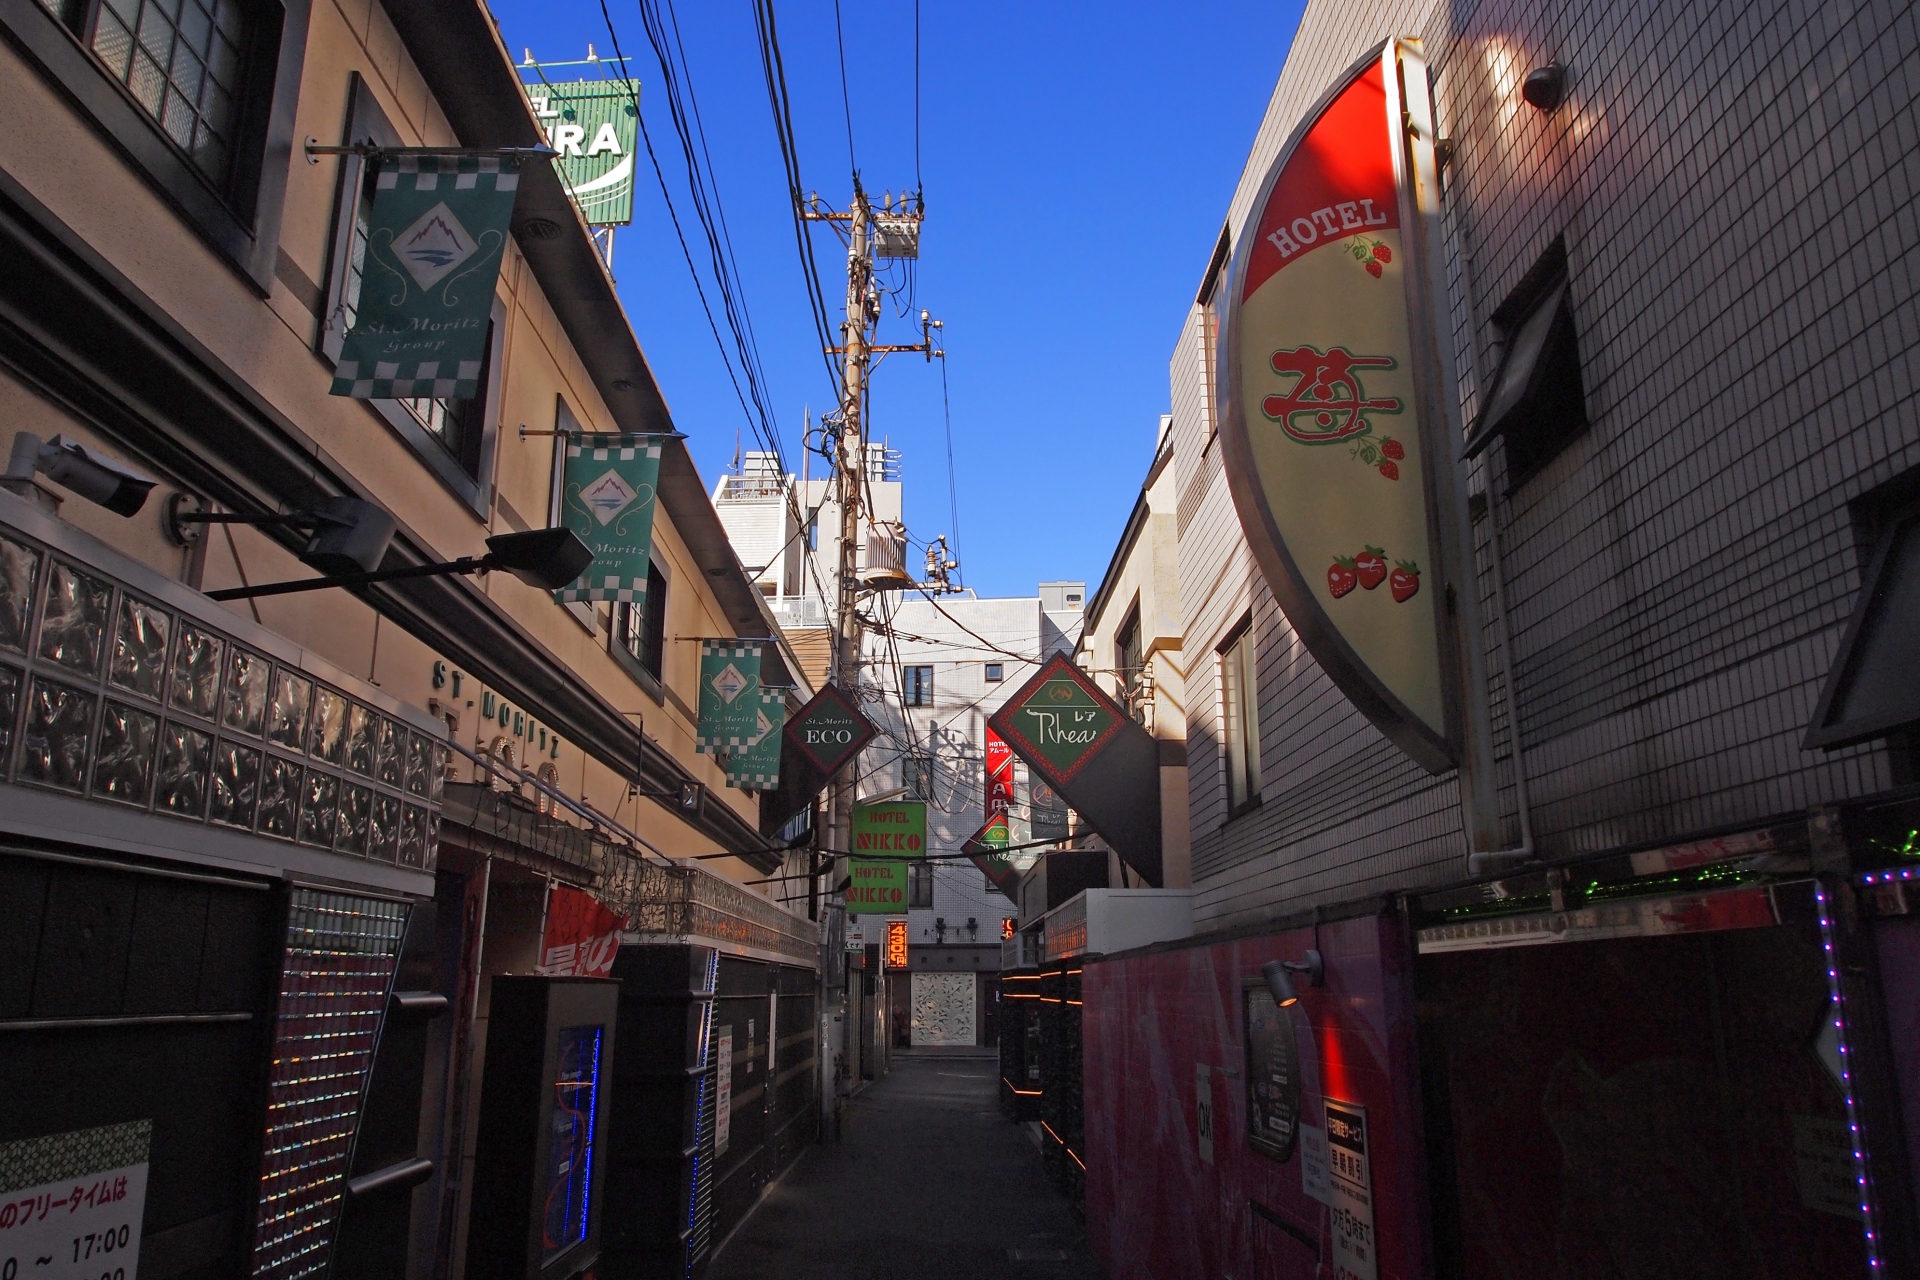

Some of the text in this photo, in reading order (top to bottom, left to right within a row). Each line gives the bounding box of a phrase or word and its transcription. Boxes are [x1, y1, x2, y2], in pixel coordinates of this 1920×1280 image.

[1267, 198, 1387, 259] HOTEL
[382, 340, 445, 353] Group
[591, 559, 622, 568] roup
[1074, 710, 1096, 722] レア
[1026, 708, 1097, 744] Rhea
[805, 729, 852, 744] ECO
[869, 811, 909, 823] HOTEL
[856, 832, 921, 851] NIKKO
[855, 867, 894, 879] HOTEL
[845, 887, 903, 904] NIKKO
[0, 1176, 128, 1230] のフリータイムは
[72, 1223, 130, 1263] 17:00
